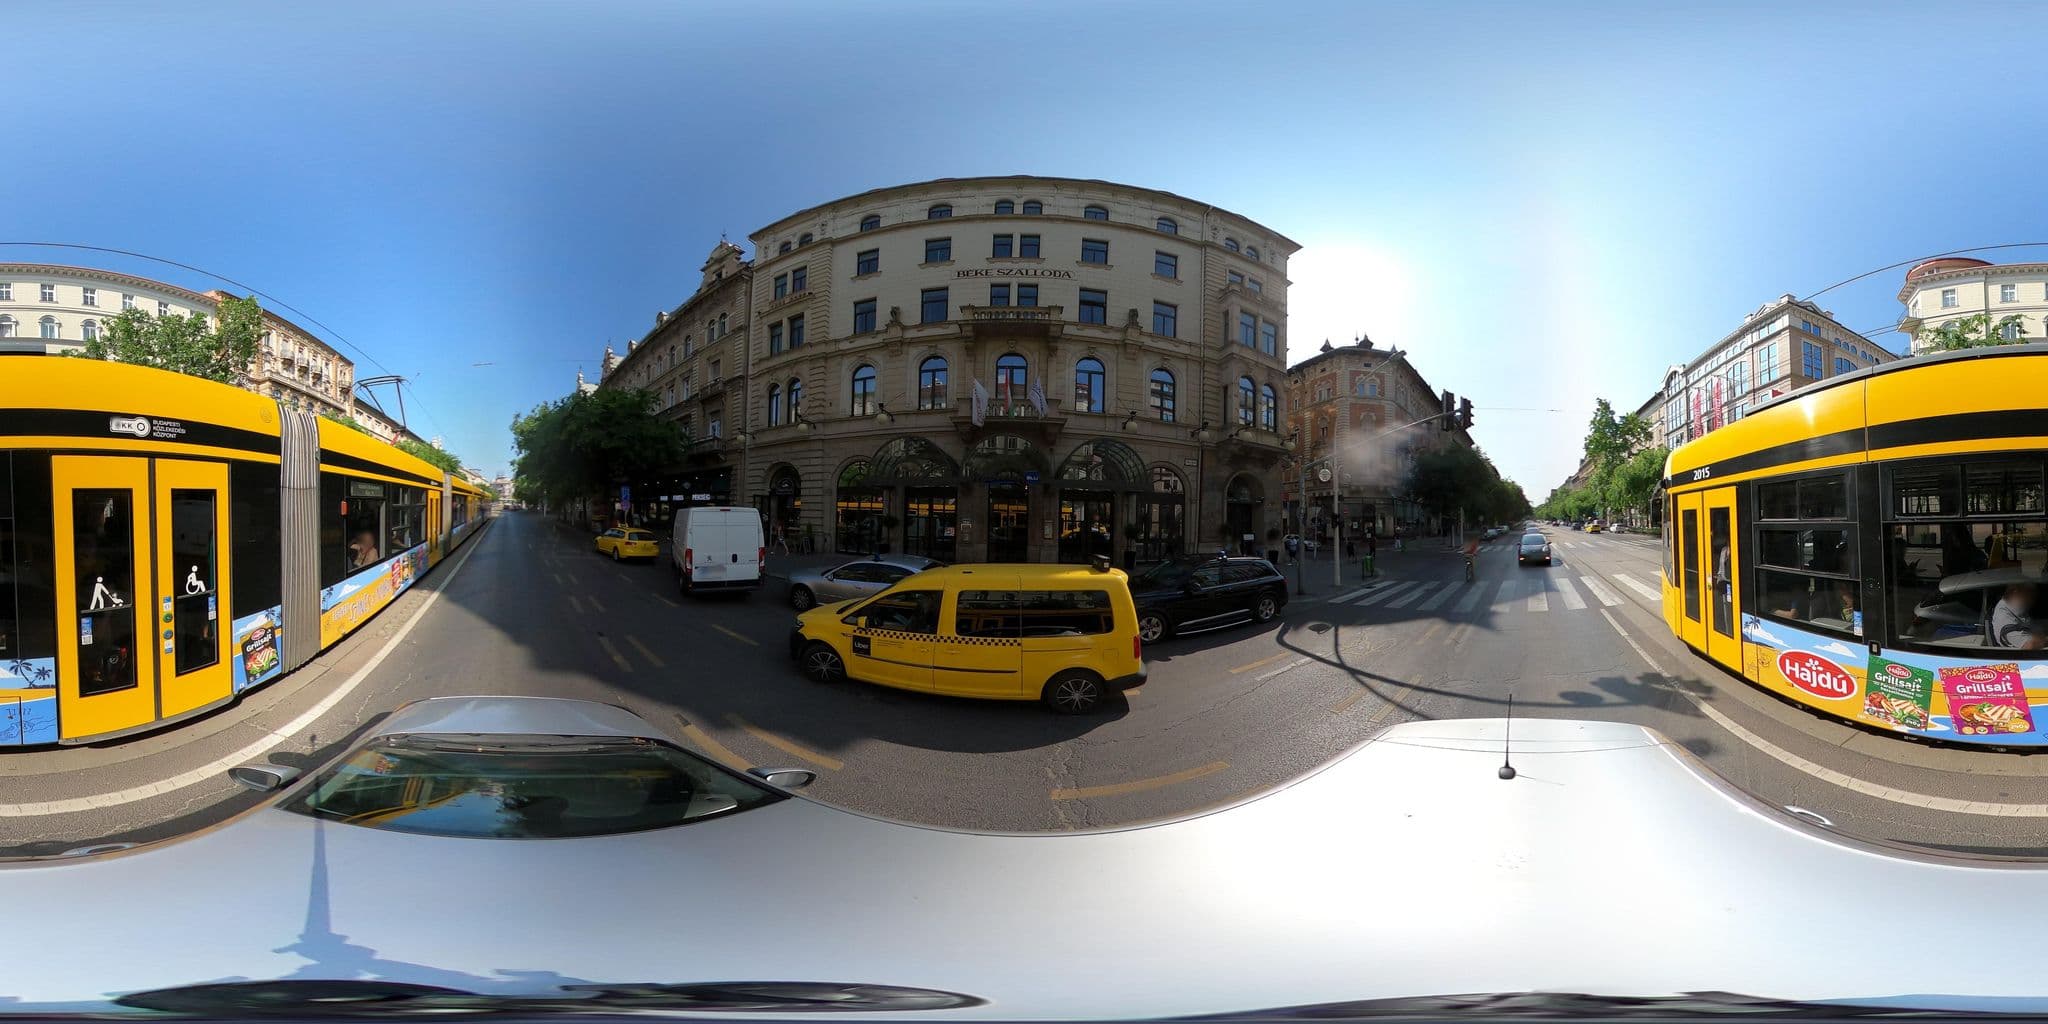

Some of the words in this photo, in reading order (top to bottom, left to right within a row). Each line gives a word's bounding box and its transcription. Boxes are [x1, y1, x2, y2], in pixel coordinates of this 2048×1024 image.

[153, 426, 186, 434] KÖZLEKEDÉSI
[1693, 467, 1710, 480] 2015
[855, 641, 869, 649] Uber
[1785, 658, 1848, 694] Hajdú
[1888, 666, 1909, 677] Hajdú
[1969, 672, 1994, 680] Hajdú
[1875, 672, 1922, 691] Grillsajt
[1956, 681, 2013, 693] Grillsajt
